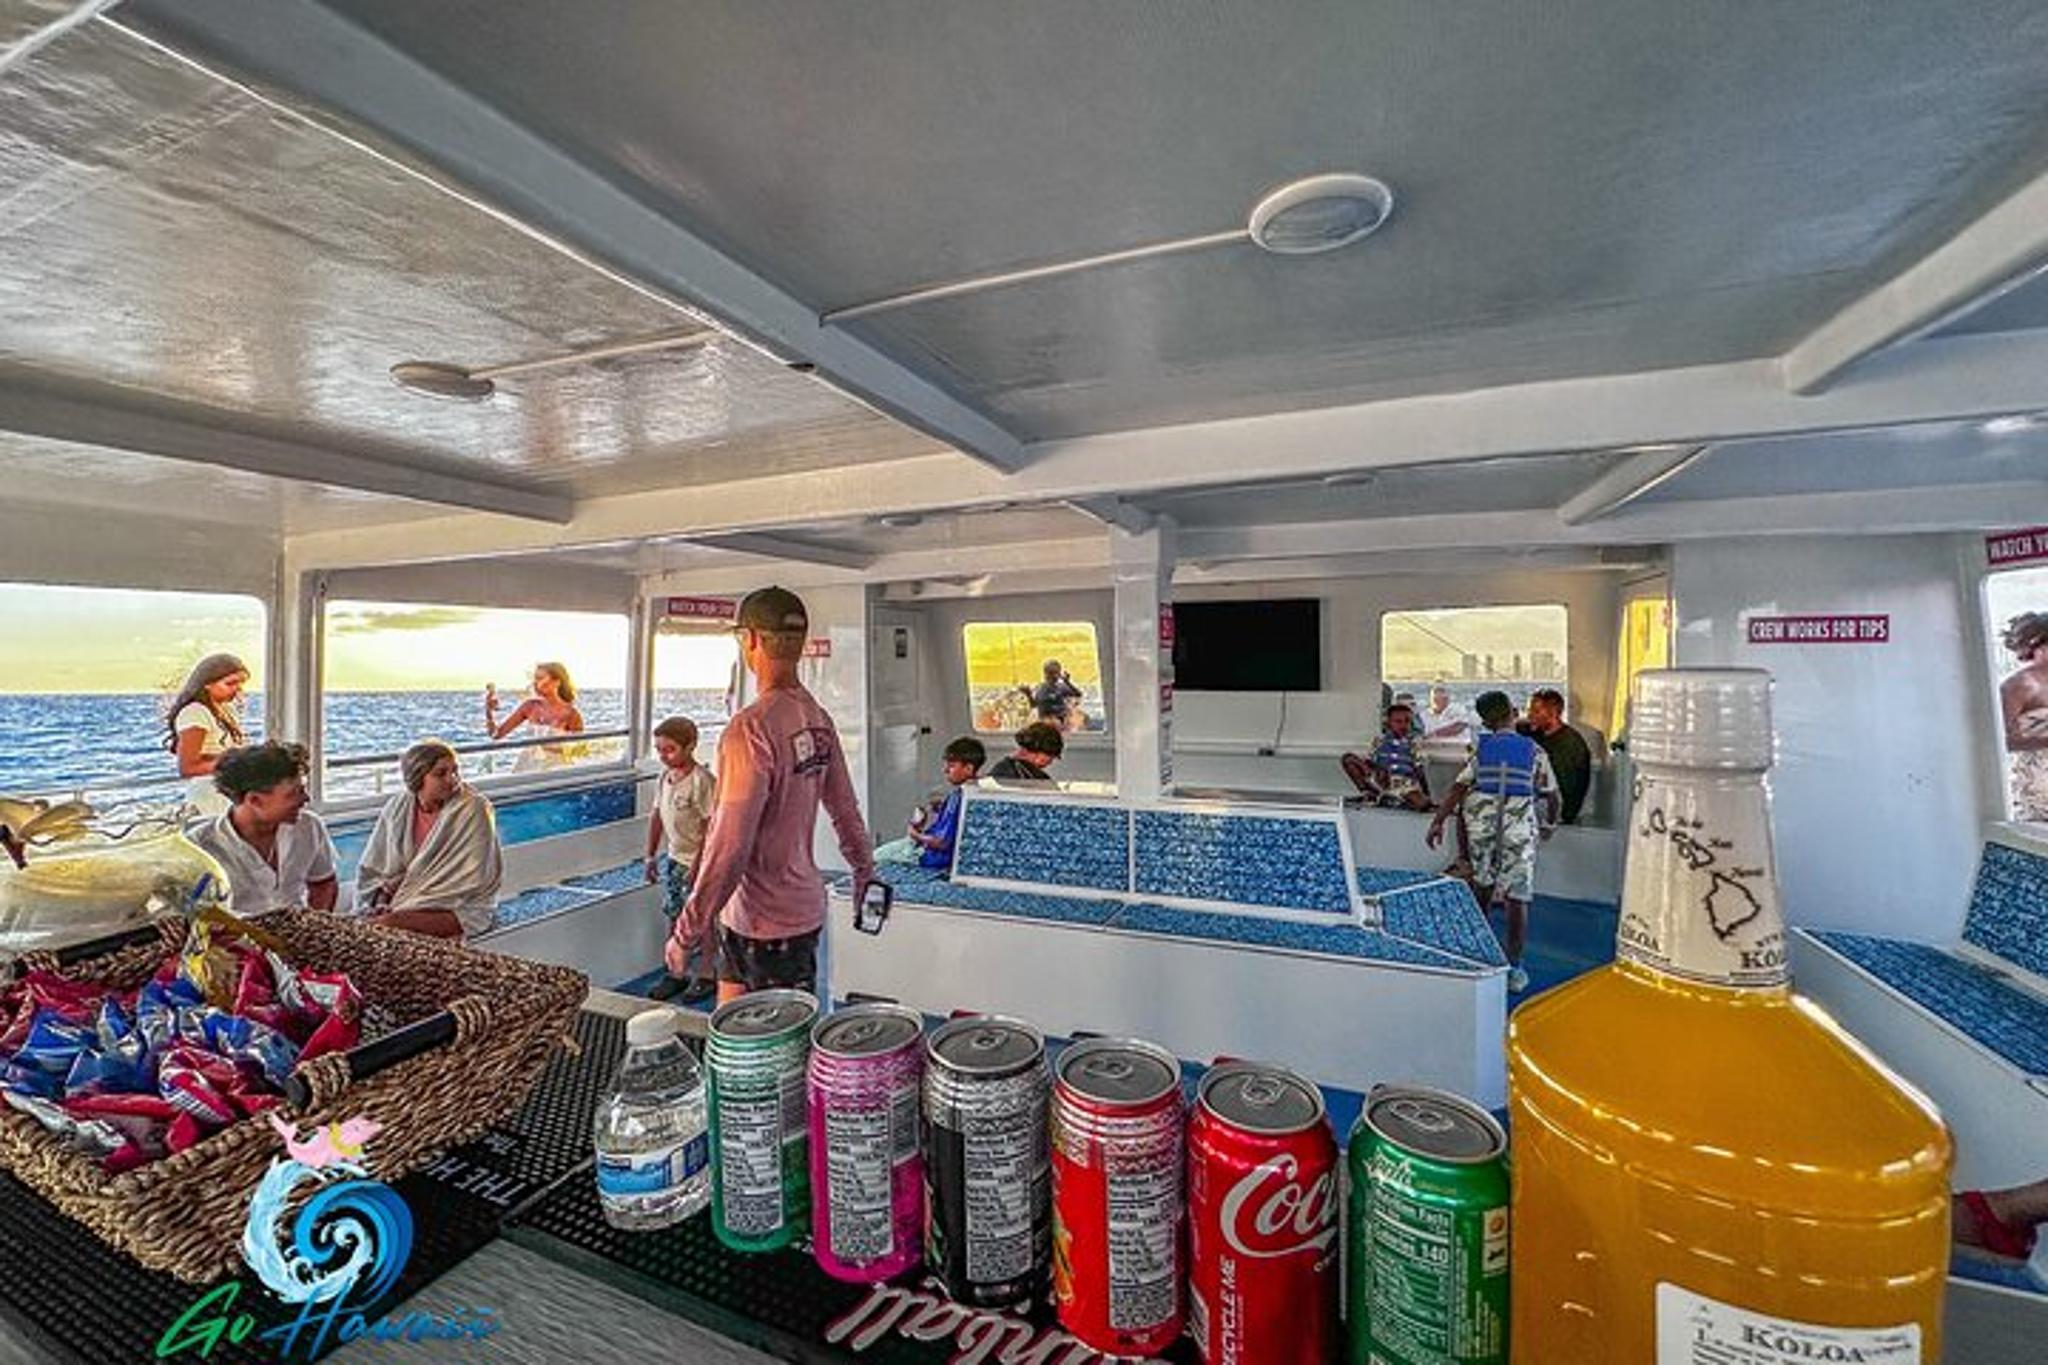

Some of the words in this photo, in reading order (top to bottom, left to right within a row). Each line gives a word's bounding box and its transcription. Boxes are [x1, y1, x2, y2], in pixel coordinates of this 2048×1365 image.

[1751, 621, 1784, 639] CREW
[1788, 620, 1830, 638] WORKS
[1831, 620, 1856, 638] FOR
[1859, 619, 1886, 638] TIPS
[1420, 1242, 1450, 1264] 140
[1219, 1254, 1236, 1289] ME
[1742, 1324, 1865, 1363] KOLOA
